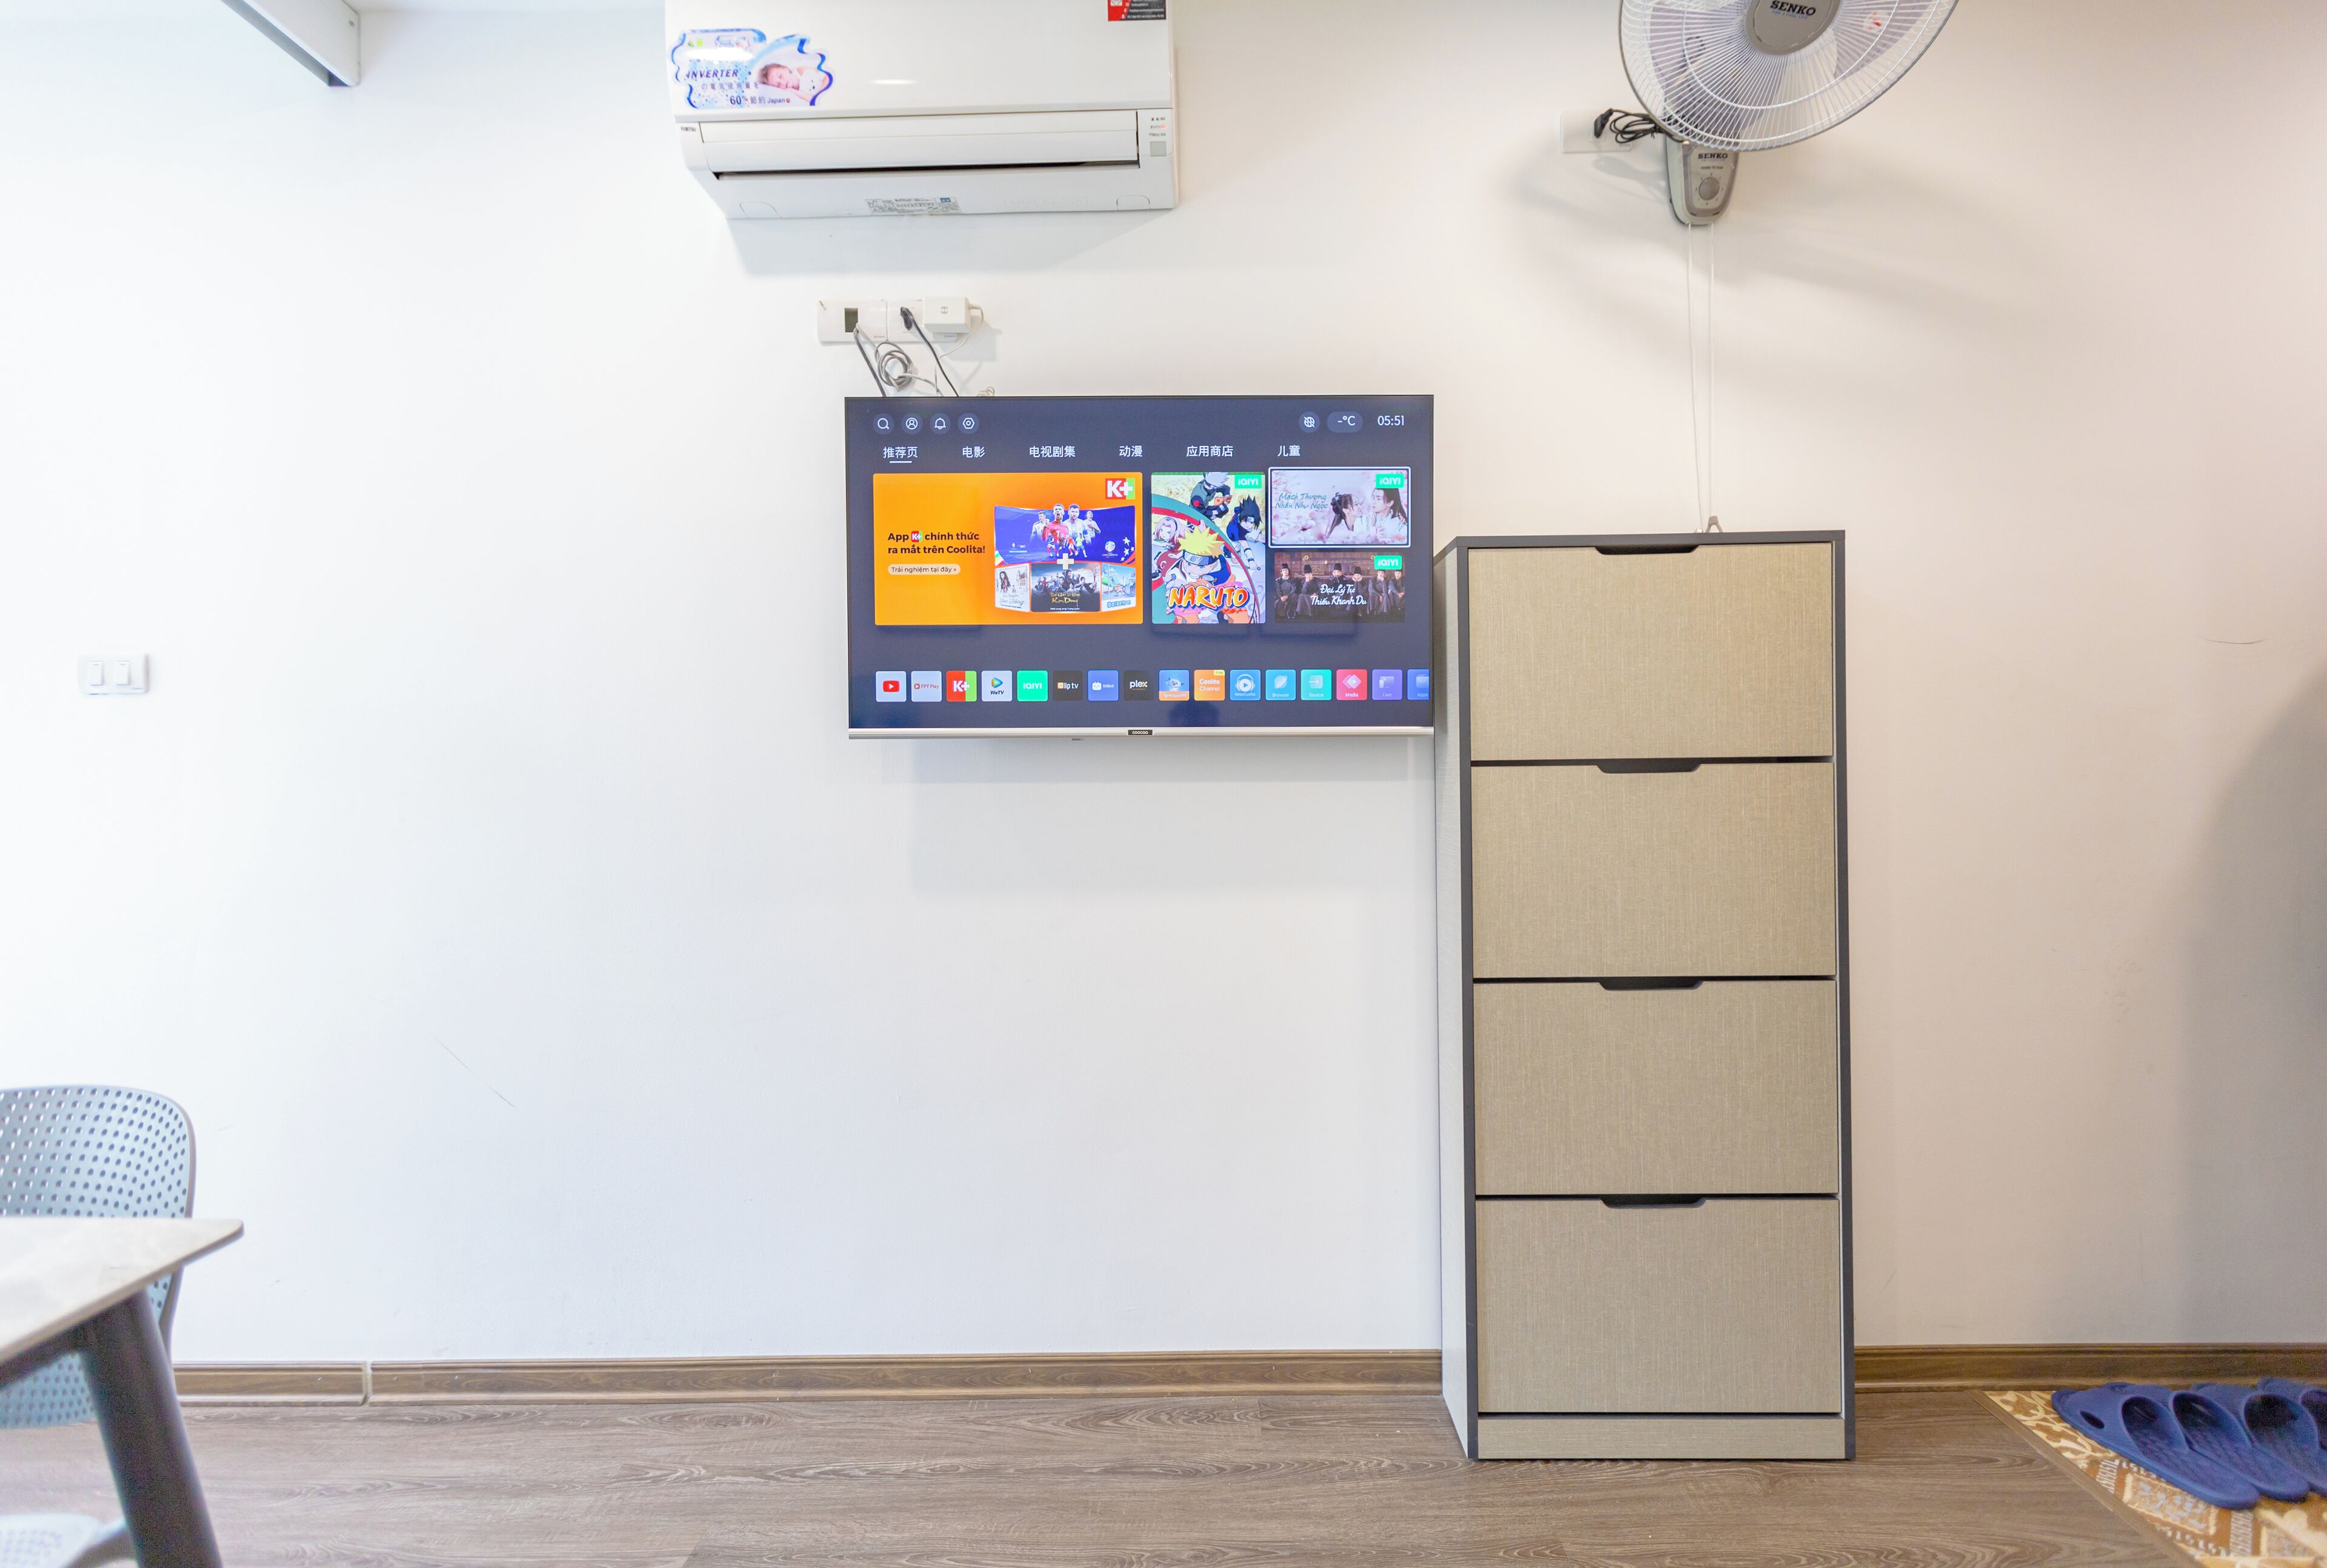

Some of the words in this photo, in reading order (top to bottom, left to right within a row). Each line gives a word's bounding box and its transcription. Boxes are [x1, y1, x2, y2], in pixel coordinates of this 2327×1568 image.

[1770, 0, 1816, 16] SENKO
[686, 68, 739, 79] INVERTER
[1377, 415, 1405, 426] 05:51
[883, 446, 918, 459] 推荐页
[962, 446, 985, 458] 电影
[1029, 445, 1076, 458] 电视剧集
[1119, 445, 1143, 457] 动漫
[1186, 445, 1234, 457] 应用商店
[1277, 445, 1300, 457] 儿童
[1107, 480, 1133, 497] K+
[888, 533, 909, 542] App
[925, 532, 953, 540] chính
[956, 531, 979, 540] thức
[901, 544, 920, 553] mắt
[947, 545, 985, 553] Coolita!
[1320, 583, 1334, 595] Đại
[1335, 584, 1346, 596] Lý
[1168, 584, 1250, 611] NARUTO
[1310, 595, 1331, 605] Thiếu
[1331, 595, 1355, 605] Khanh
[1356, 595, 1367, 605] Du
[953, 680, 970, 692] K+
[1130, 679, 1148, 689] plex
